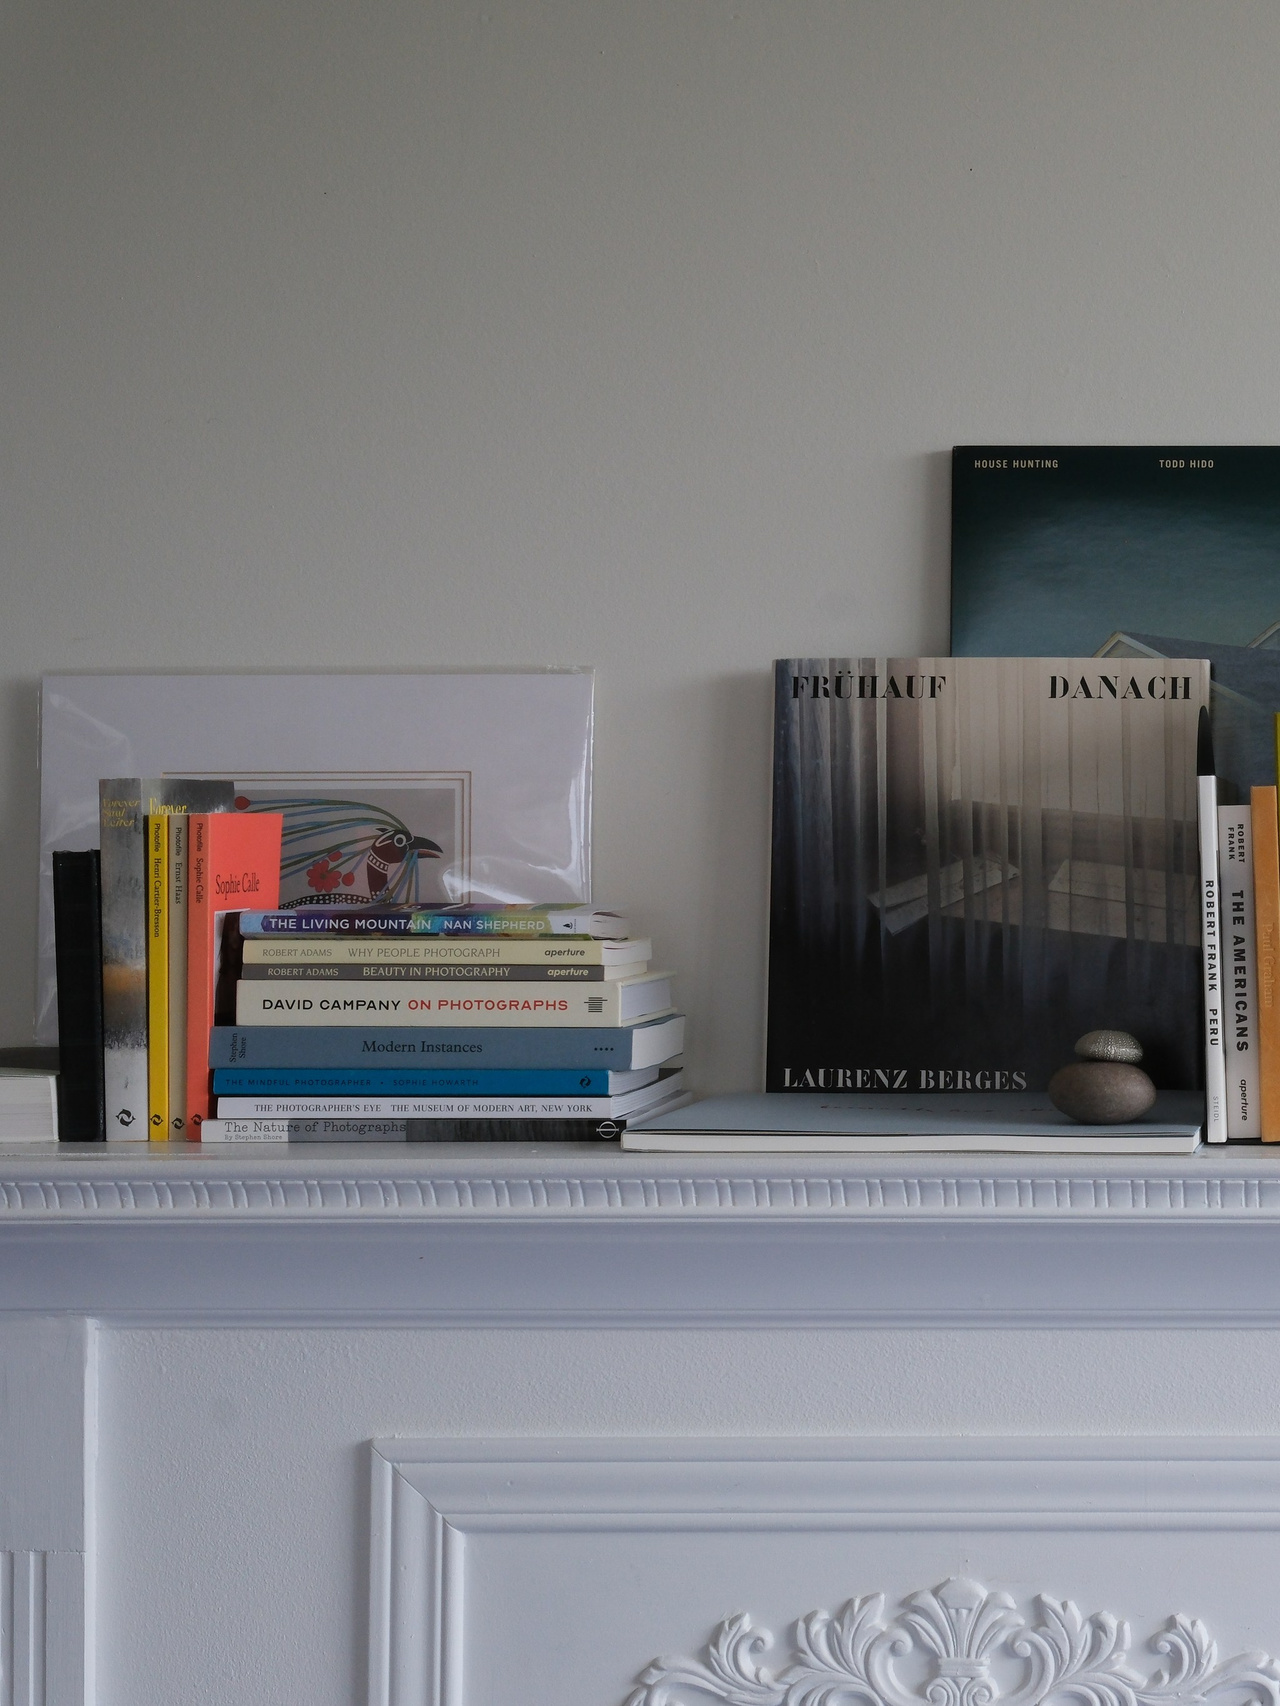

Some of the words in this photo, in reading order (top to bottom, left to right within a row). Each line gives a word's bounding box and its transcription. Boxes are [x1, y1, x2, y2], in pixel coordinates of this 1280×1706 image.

[974, 459, 1008, 469] HOUSE
[1013, 459, 1059, 469] HUNTING
[1159, 459, 1185, 469] TODD
[1190, 459, 1215, 469] HIDO
[791, 670, 947, 699] FRÜHAUF
[1048, 675, 1193, 700] DANACH
[1237, 823, 1245, 863] ROBERT
[195, 858, 203, 881] Sophie
[215, 875, 240, 900] Sophie
[242, 873, 260, 893] Calle
[153, 880, 161, 938] Cartier-Bresson
[1205, 880, 1216, 936] ROBERT
[1232, 890, 1245, 925] THE
[270, 918, 297, 929] THE
[302, 918, 350, 930] LIVING
[355, 919, 431, 930] MOUNTAIN
[443, 920, 472, 930] NAN
[476, 920, 545, 930] SHEPHERD
[262, 948, 298, 957] ROBERT
[300, 948, 333, 957] ADAMS
[348, 948, 373, 957] WHY
[377, 948, 420, 957] PEOPLE
[424, 948, 500, 957] PHOTOGRAPH
[544, 948, 586, 958] aperture
[267, 968, 303, 976] ROBERT
[306, 968, 339, 976] ADAMS
[363, 967, 407, 976] BEAUTY
[410, 967, 421, 976] IN
[425, 967, 510, 977] PHOTOGRAPHY
[547, 968, 589, 977] aperture
[1207, 944, 1217, 991] FRANK
[1233, 935, 1249, 1051] AMERICANS
[1263, 955, 1277, 1007] Graham
[262, 999, 313, 1010] DAVID
[319, 999, 401, 1010] CAMPANY
[408, 999, 431, 1010] ON
[438, 1000, 569, 1011] PHOTOGRAPHS
[1209, 1008, 1219, 1046] PERU
[229, 1032, 238, 1063] Stephen
[361, 1040, 416, 1053] Modern
[421, 1041, 483, 1053] Instances
[783, 1067, 908, 1089] LAURENZ
[919, 1070, 1027, 1091] BERGES
[254, 1104, 272, 1112] THE
[363, 1104, 382, 1112] EYE
[391, 1104, 409, 1112] THE
[413, 1104, 454, 1112] MUSEUM
[457, 1104, 470, 1112] OF
[473, 1104, 514, 1112] MODERN
[517, 1104, 538, 1113] ART,
[541, 1104, 563, 1112] NEW
[567, 1104, 592, 1112] YORK
[1212, 1096, 1220, 1122] STEIDL
[1239, 1079, 1249, 1121] aperture
[224, 1121, 248, 1133] The
[253, 1121, 300, 1133] Nature
[305, 1121, 319, 1133] of
[323, 1121, 407, 1136] Photographs
